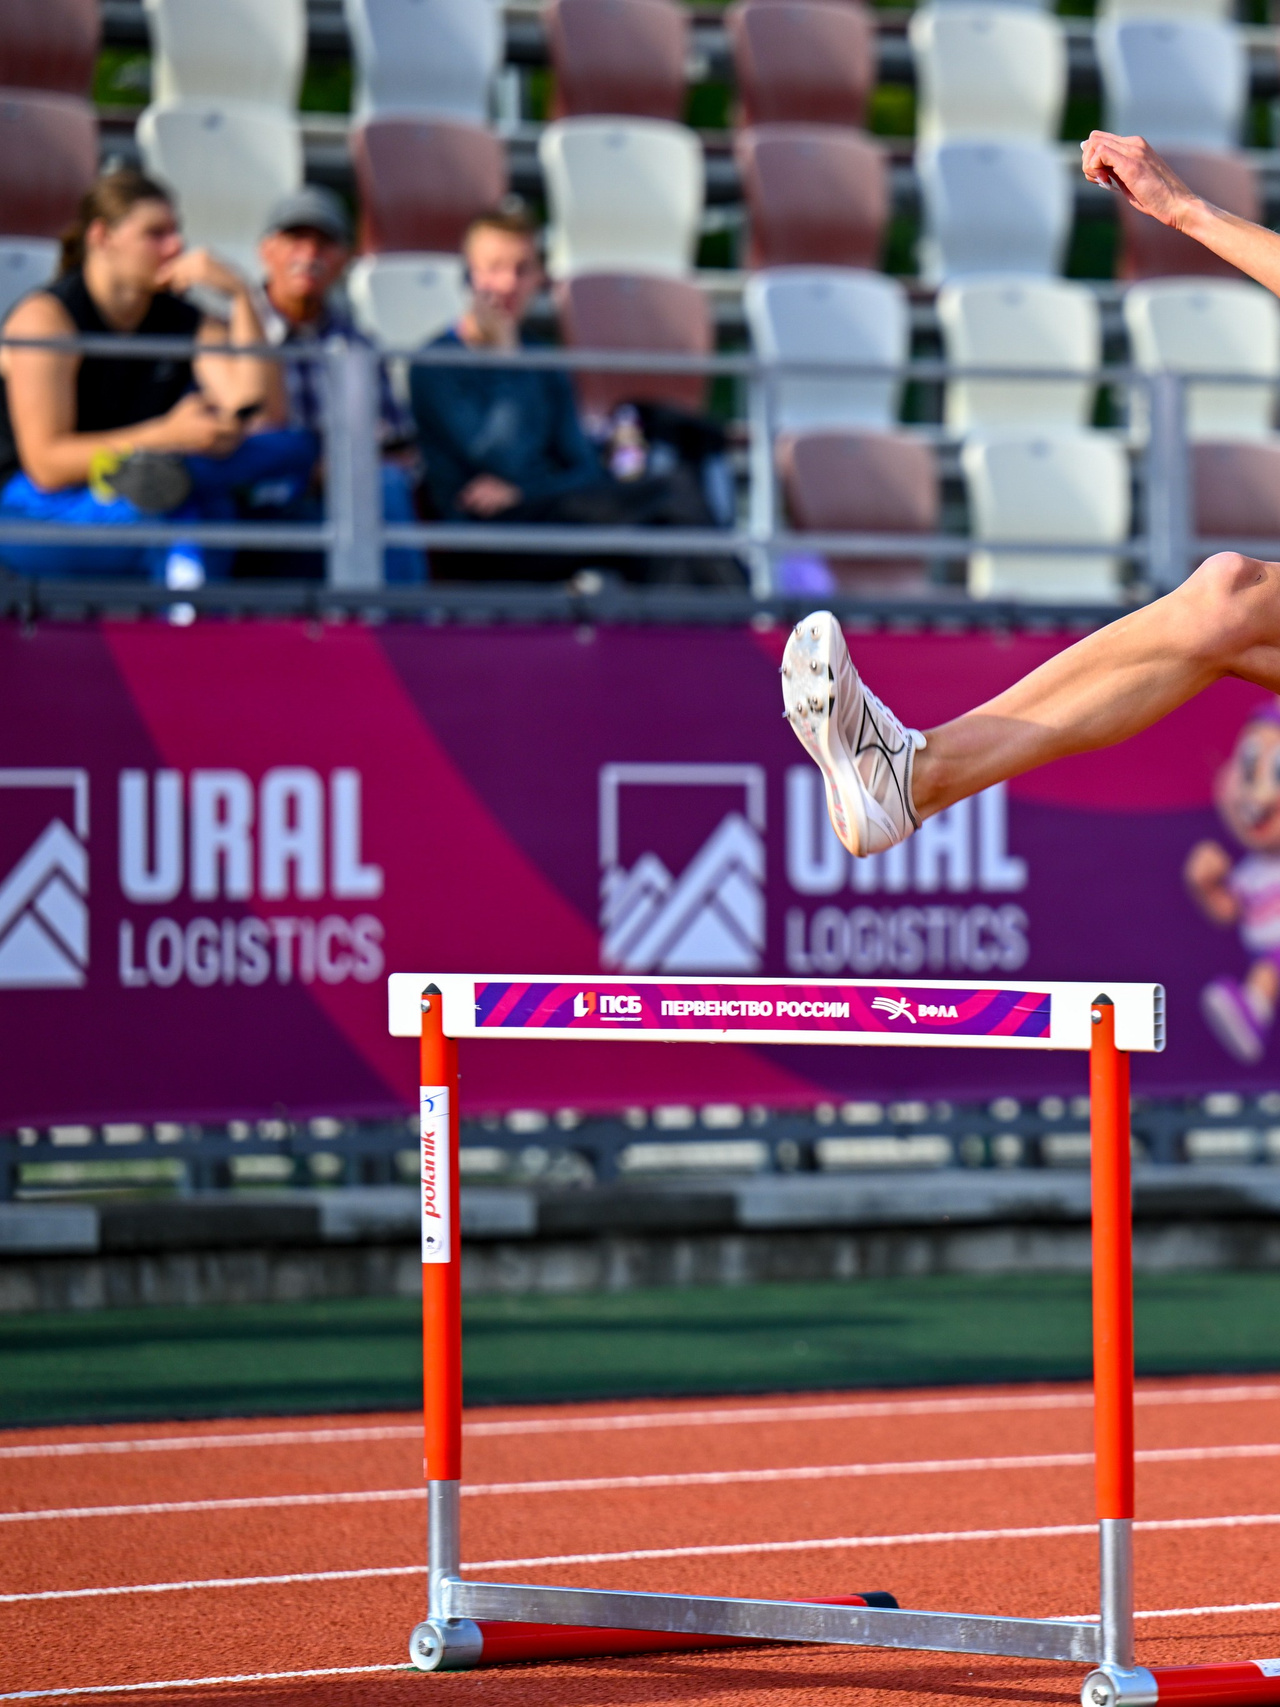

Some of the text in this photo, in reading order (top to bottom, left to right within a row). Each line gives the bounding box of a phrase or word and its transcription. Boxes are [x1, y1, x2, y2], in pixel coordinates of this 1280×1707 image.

[119, 766, 384, 904] URAL
[119, 913, 385, 988] LOGISTICS
[785, 904, 1028, 973] LOGISTICS
[600, 995, 642, 1014] ПСБ
[661, 1000, 850, 1018] ПЕРВЕНСТВО РОССИИ
[918, 1004, 959, 1018] ВФЛА
[421, 1130, 442, 1219] polanik
